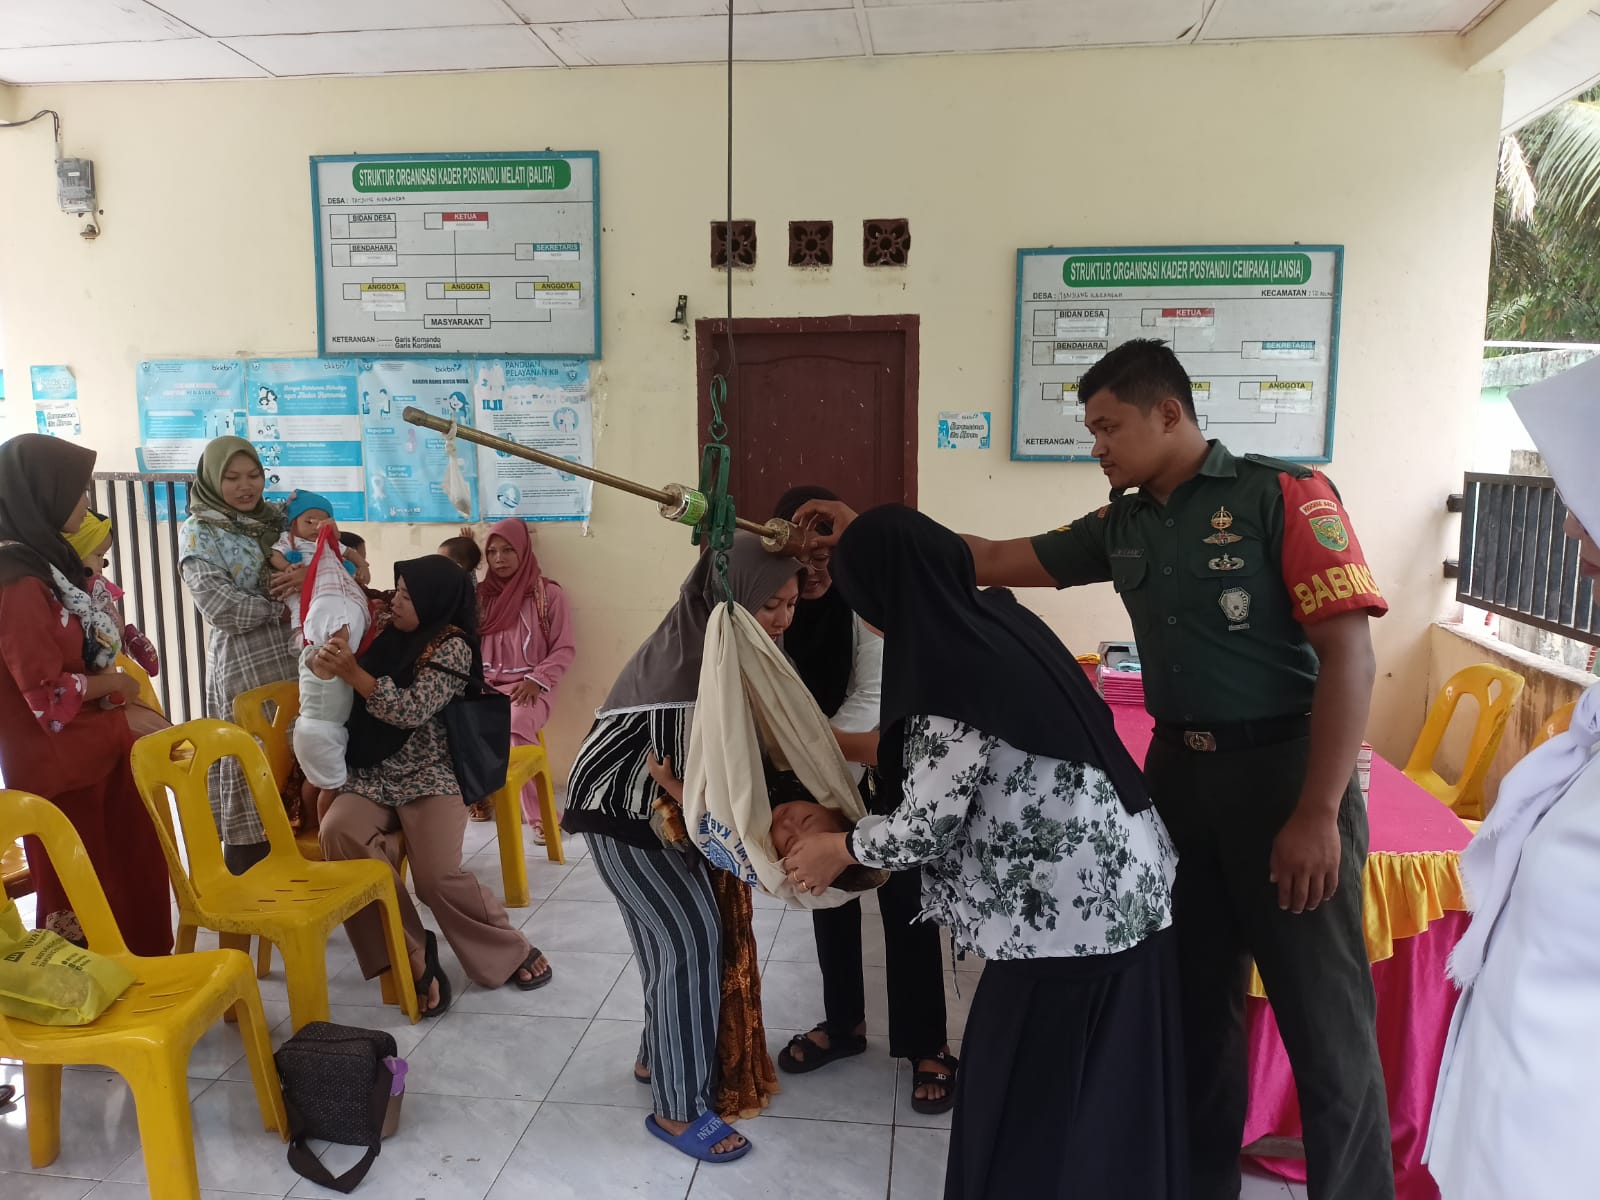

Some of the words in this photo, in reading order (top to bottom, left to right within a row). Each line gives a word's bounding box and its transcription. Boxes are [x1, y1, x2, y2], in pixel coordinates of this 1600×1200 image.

[359, 168, 395, 187] STRUKTUR
[395, 167, 437, 186] ORGANISASI
[438, 167, 462, 185] KADER
[462, 166, 500, 185] POSYANDU
[501, 165, 526, 184] MELATI
[526, 165, 556, 188] (BALITA)
[352, 214, 371, 222] BIDAN
[536, 243, 578, 251] SEKRETARIS
[1070, 262, 1112, 281] STRUKTUR
[1112, 261, 1160, 280] ORGANISASI
[1161, 260, 1188, 279] KADER
[1189, 260, 1231, 279] POSYANDU
[1232, 259, 1270, 279] CEMPAKA
[1270, 259, 1305, 283] (LANSIA)
[1032, 292, 1053, 300] DESA
[1261, 289, 1307, 297] KECAMATAN
[1059, 310, 1082, 318] BIDAN
[1084, 309, 1105, 318] DESA
[1176, 309, 1202, 317] KETUA
[431, 318, 485, 326] MASYARAKAT
[1266, 341, 1313, 349] SEKRETARIS
[505, 368, 547, 377] PELAYANAN
